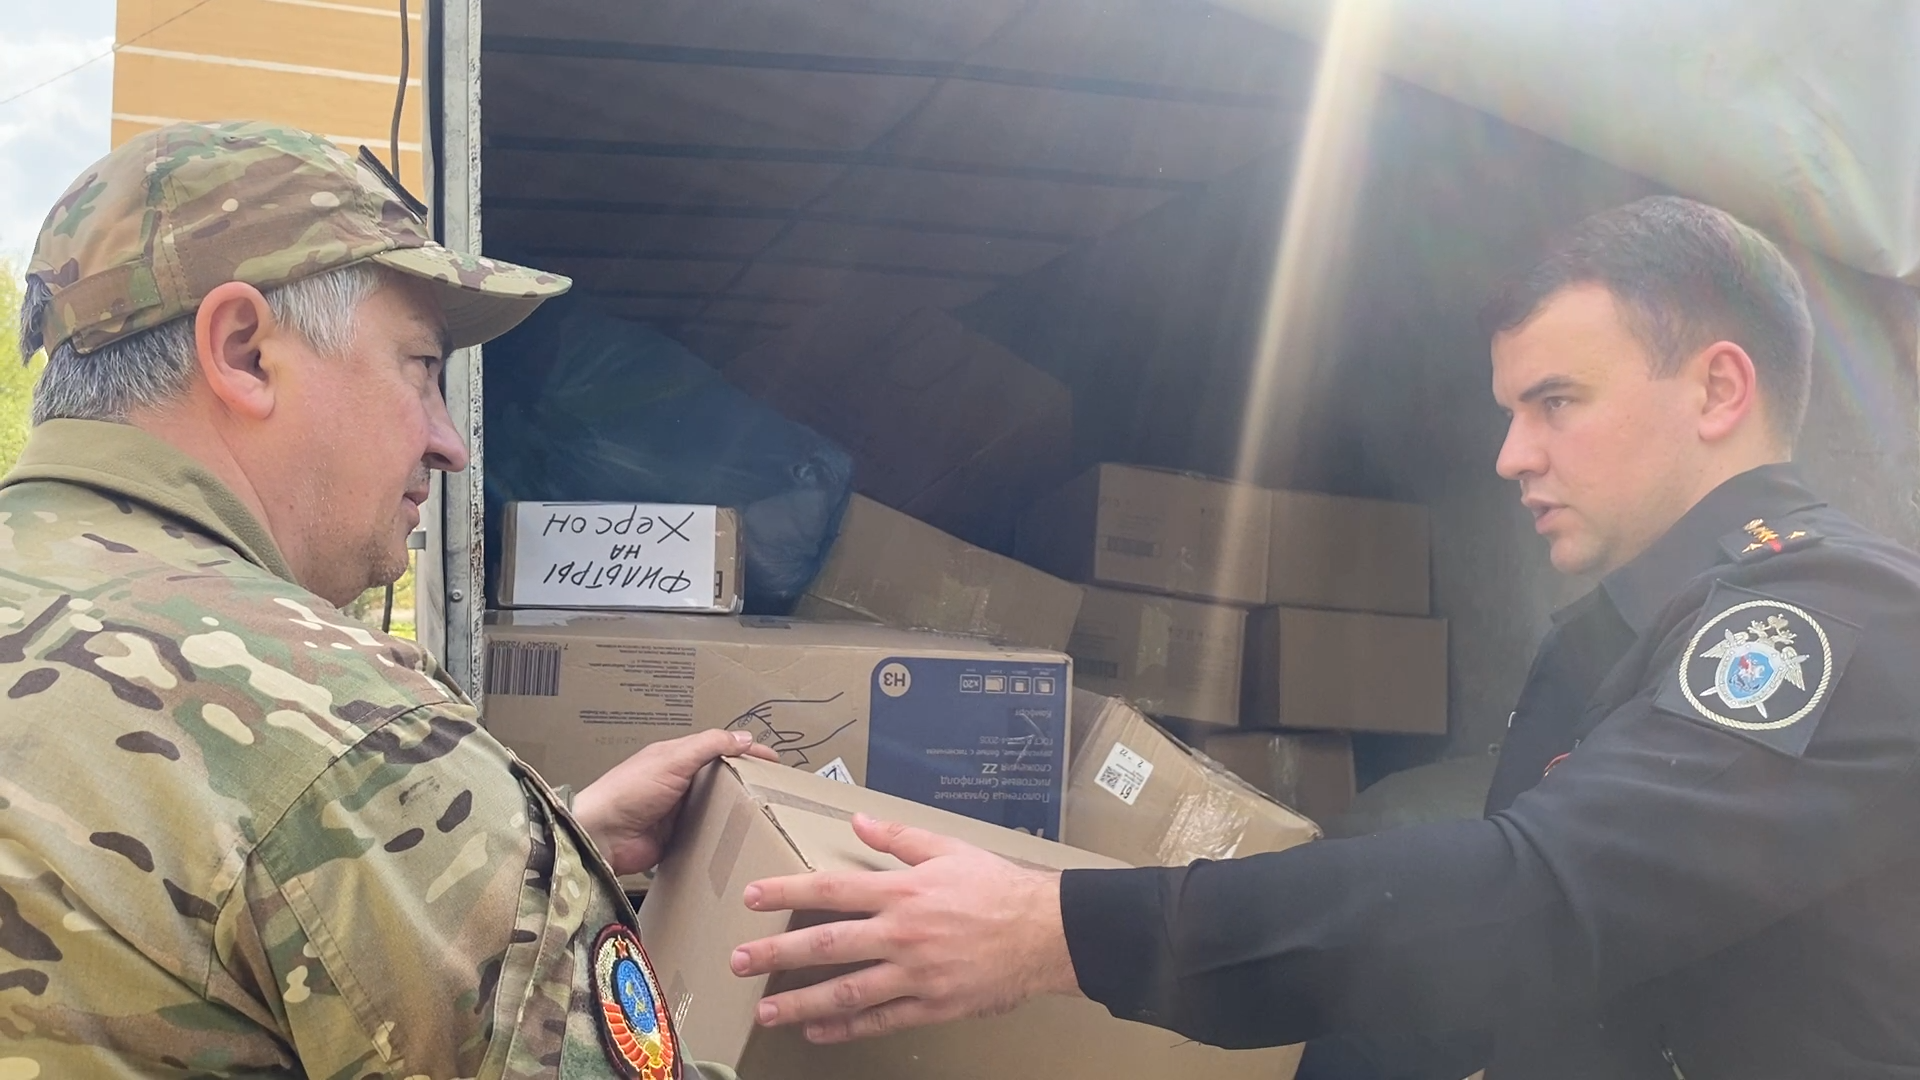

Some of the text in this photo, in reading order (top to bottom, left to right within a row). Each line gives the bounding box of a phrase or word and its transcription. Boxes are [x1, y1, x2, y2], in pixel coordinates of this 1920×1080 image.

[542, 505, 695, 544] Херсон
[542, 561, 691, 594] ФИЛЬТРЫ
[982, 763, 998, 774] ZZ
[940, 776, 1052, 788] листовые Синглфолд
[934, 789, 1050, 803] Полотенца бумажные
